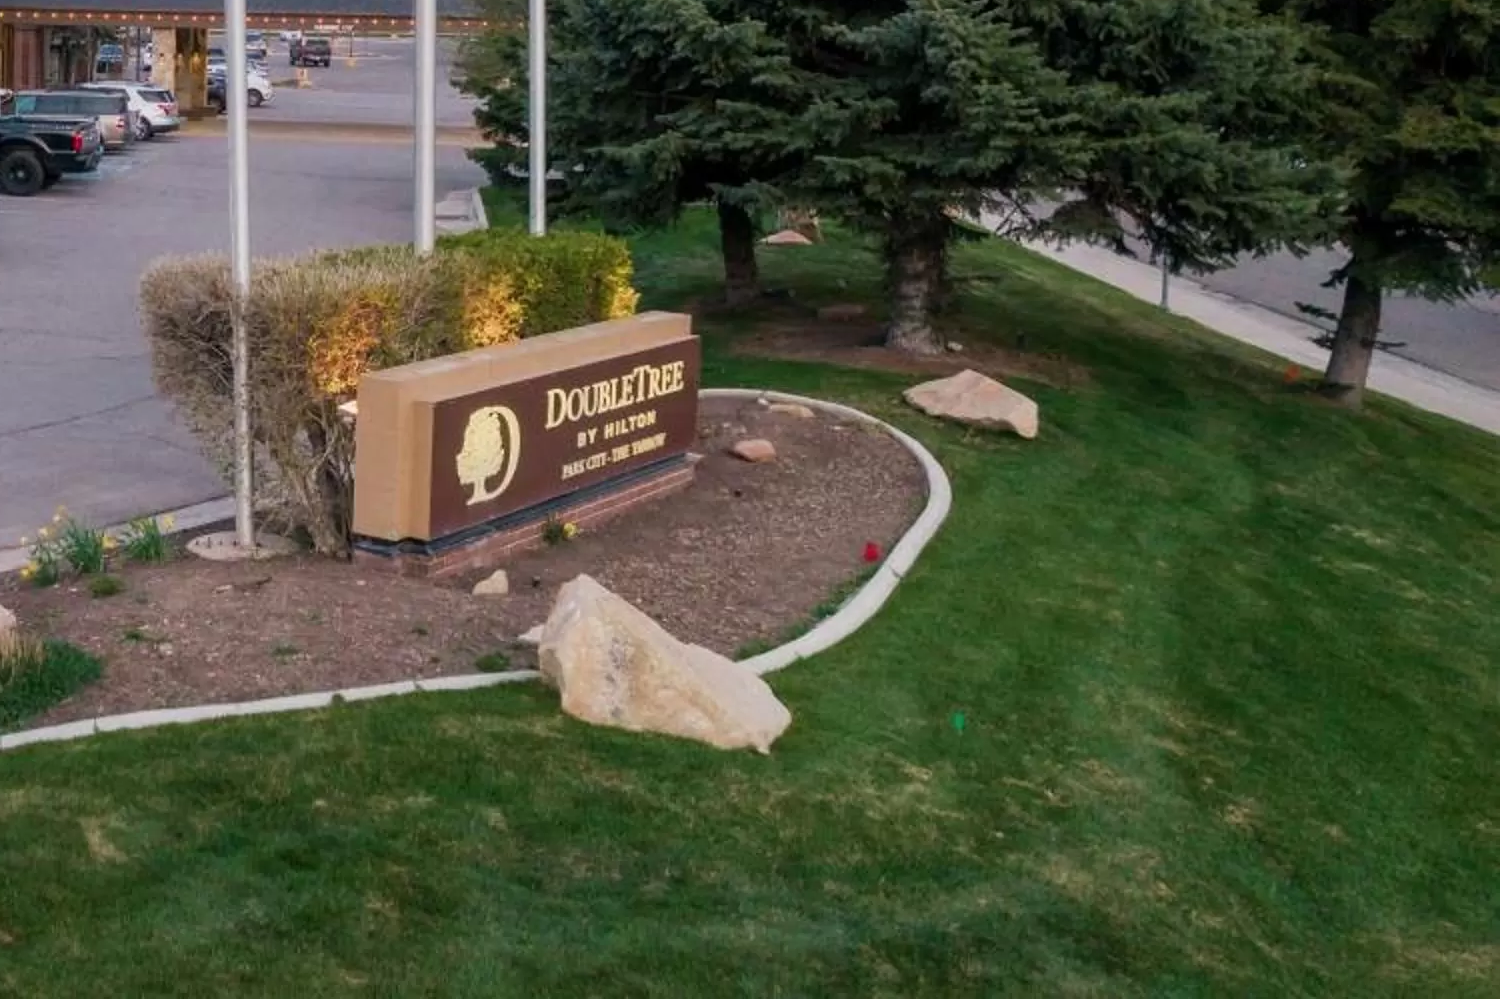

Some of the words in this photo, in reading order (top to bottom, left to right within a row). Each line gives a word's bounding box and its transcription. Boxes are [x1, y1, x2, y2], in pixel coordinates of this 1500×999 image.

[545, 360, 684, 430] DOUBLETREE
[577, 428, 597, 448] BY
[603, 409, 657, 439] HILTON
